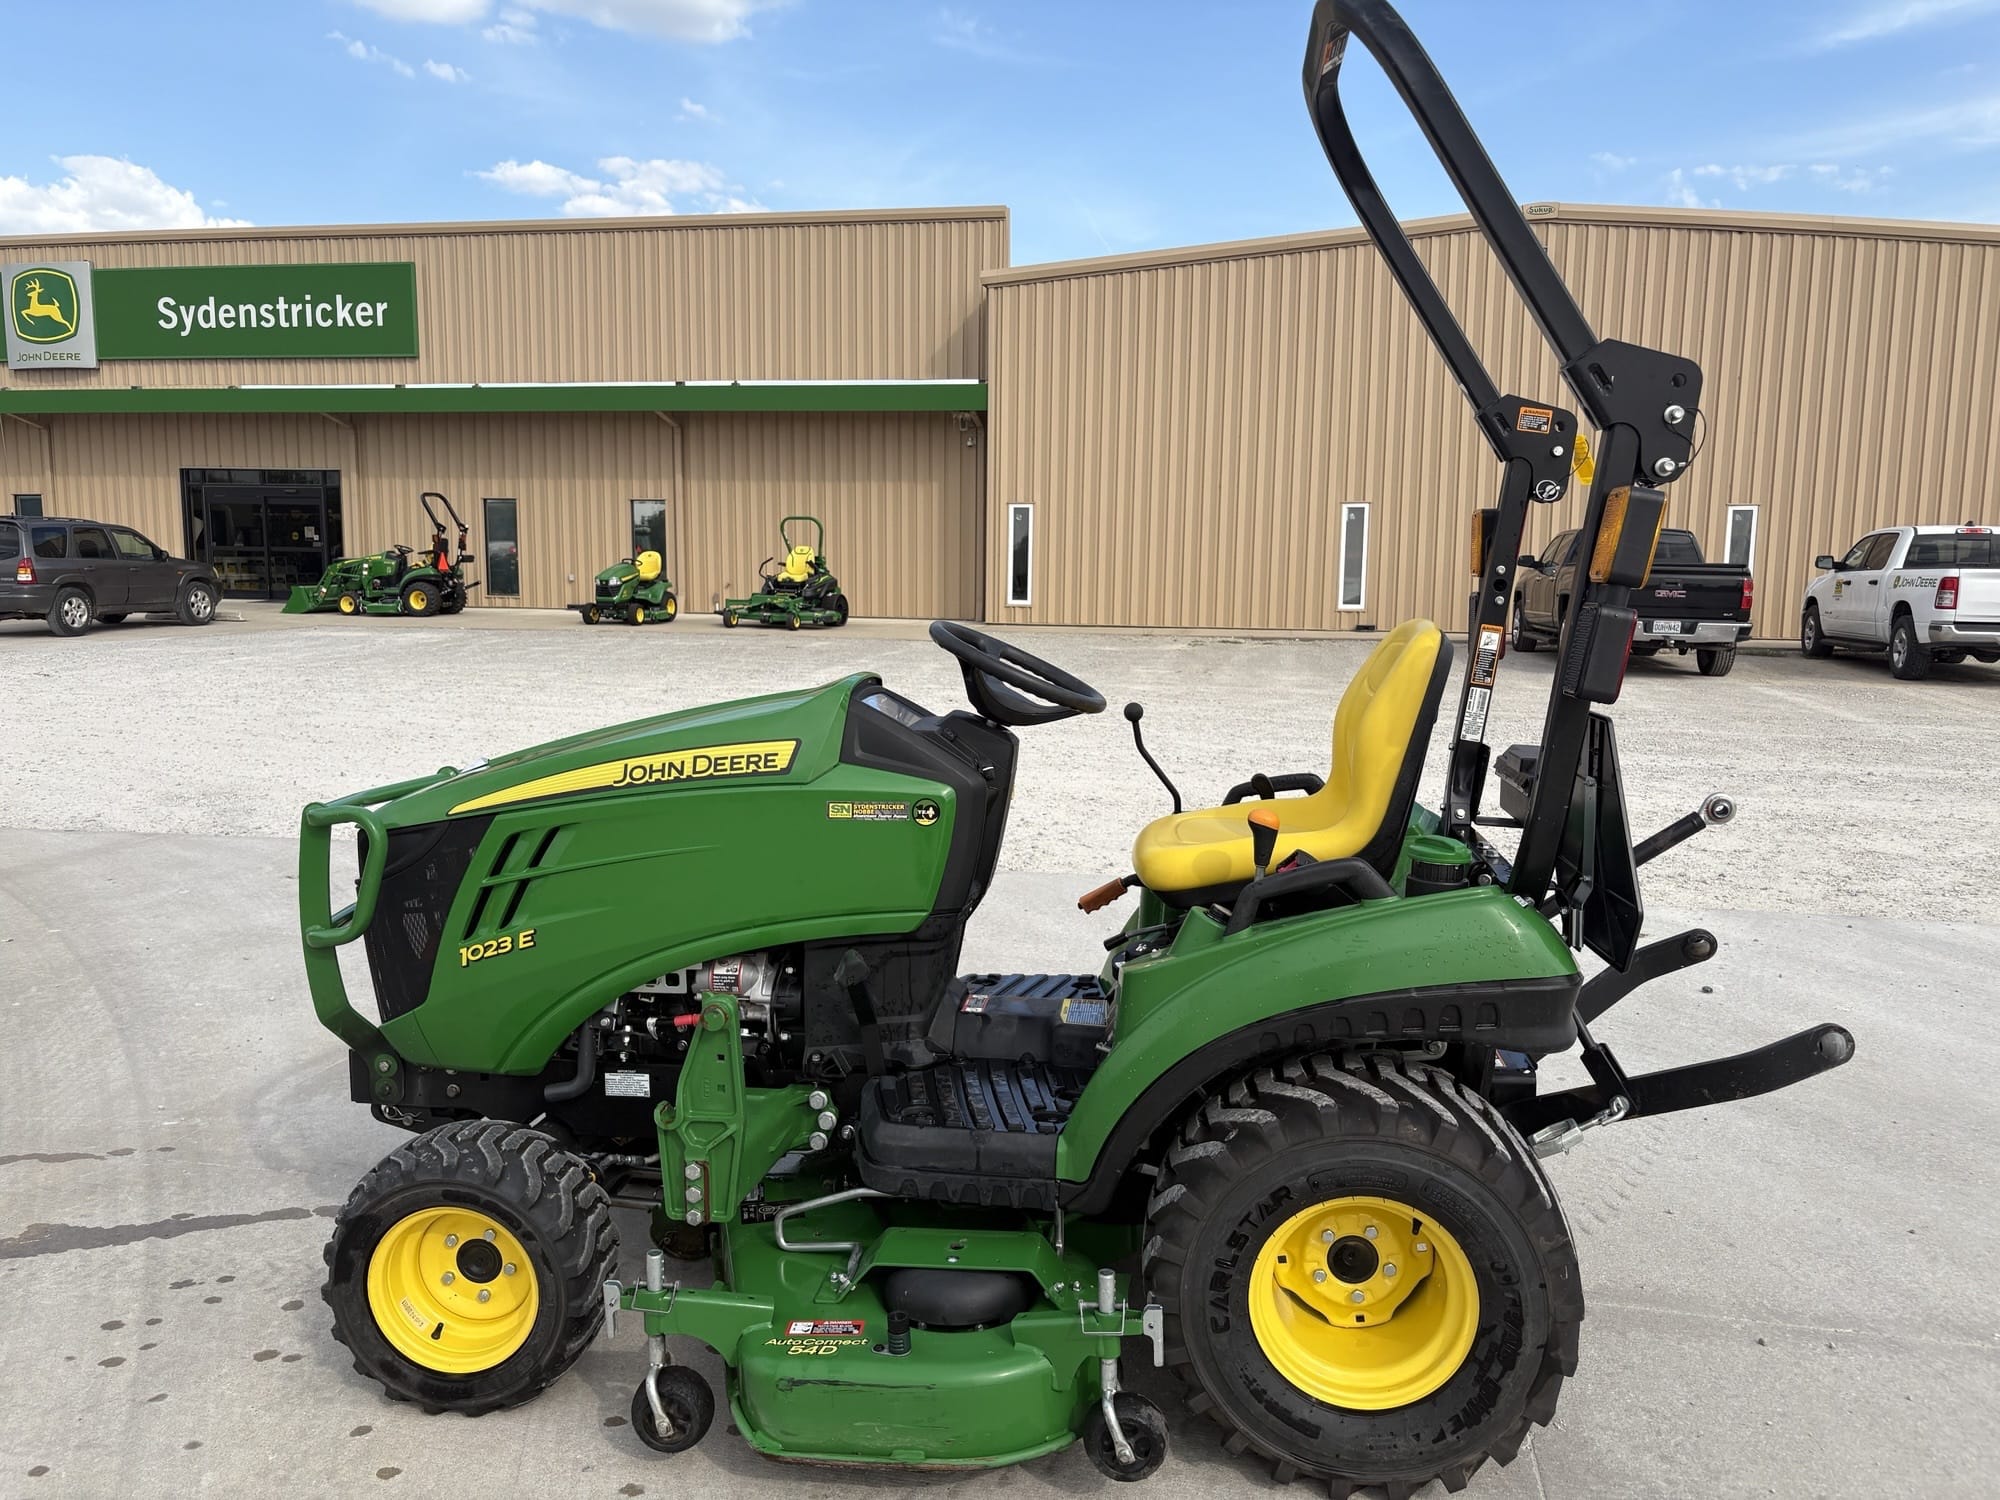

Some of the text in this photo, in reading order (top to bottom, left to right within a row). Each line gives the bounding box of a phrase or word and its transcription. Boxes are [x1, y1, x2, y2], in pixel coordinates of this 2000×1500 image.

[157, 294, 388, 337] Sydenstricker
[17, 351, 81, 362] JOHN DEERE
[1899, 575, 1938, 588] JOHN DEERE
[1655, 590, 1687, 598] GMC
[613, 752, 779, 785] JOHN DEERE
[830, 804, 851, 814] SN
[459, 929, 535, 967] 1023 E
[1209, 1185, 1295, 1334] CARLSTAR
[764, 1338, 869, 1346] AutoConnect
[787, 1345, 838, 1355] 54D
